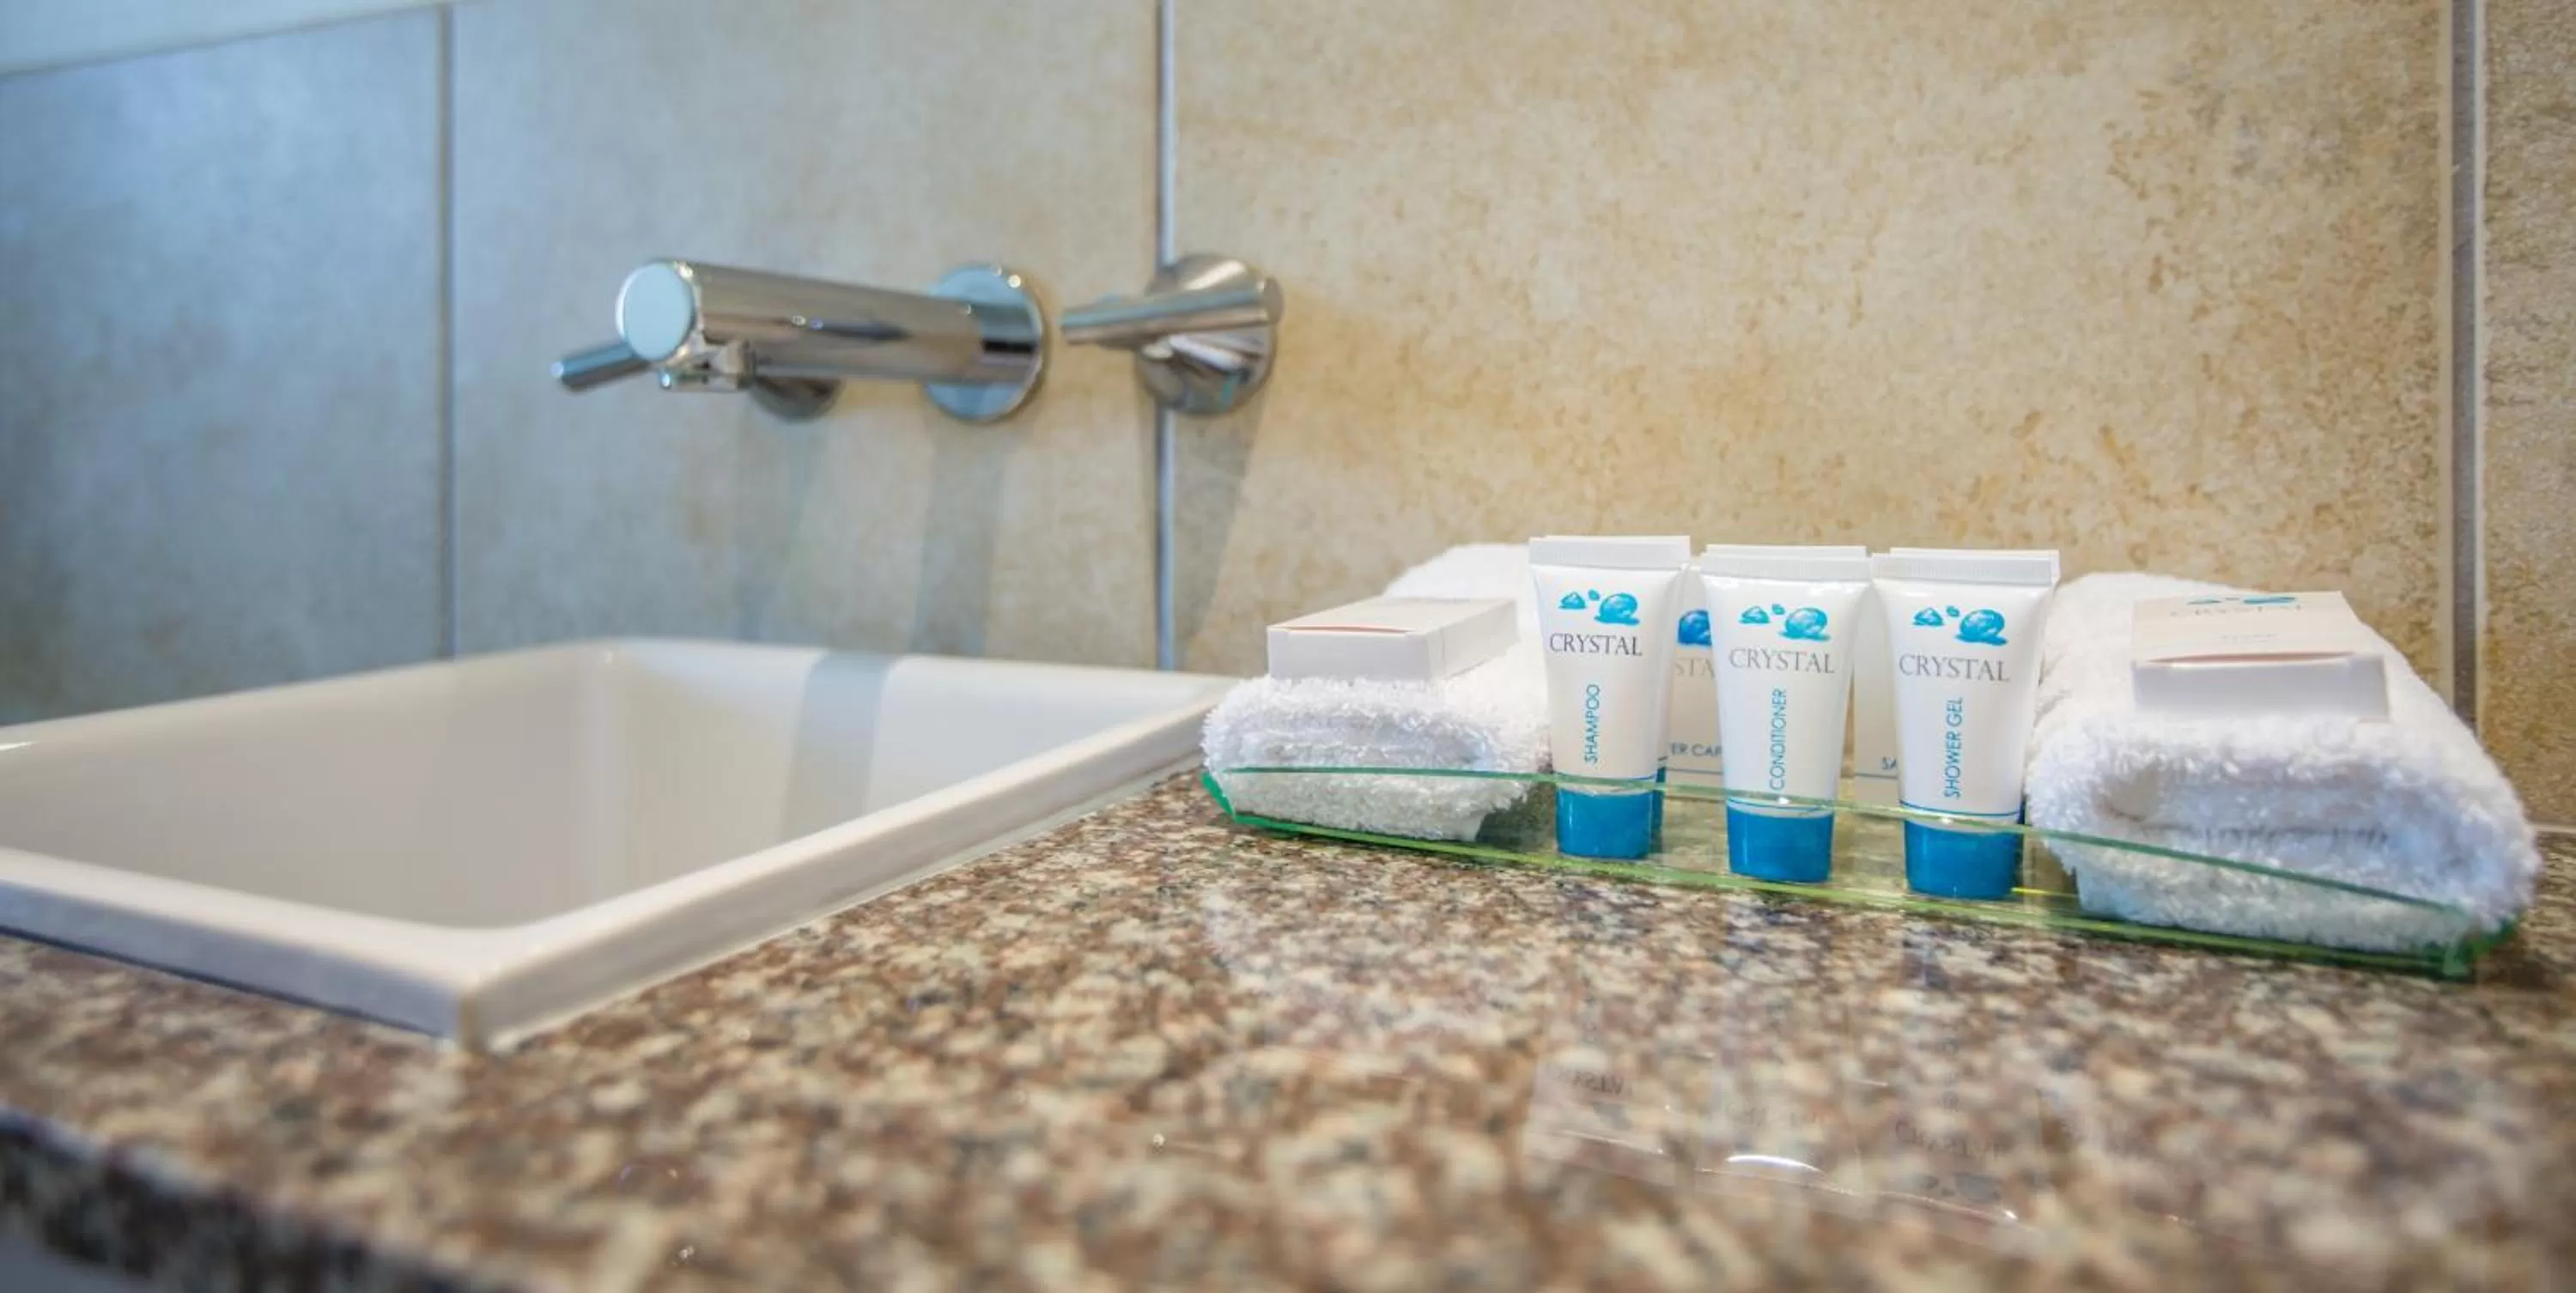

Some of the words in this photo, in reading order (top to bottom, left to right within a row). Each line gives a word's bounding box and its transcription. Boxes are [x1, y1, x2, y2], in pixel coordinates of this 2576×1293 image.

[1549, 632, 1643, 657] CRYSTAL
[1729, 647, 1836, 674] CRYSTAL
[1899, 653, 2010, 682] CRYSTAL
[1584, 684, 1601, 764] SHAMPOO
[1946, 696, 1964, 727] GEL
[1769, 688, 1787, 791] CONDITIONER
[1944, 731, 1962, 799] SHOWER
